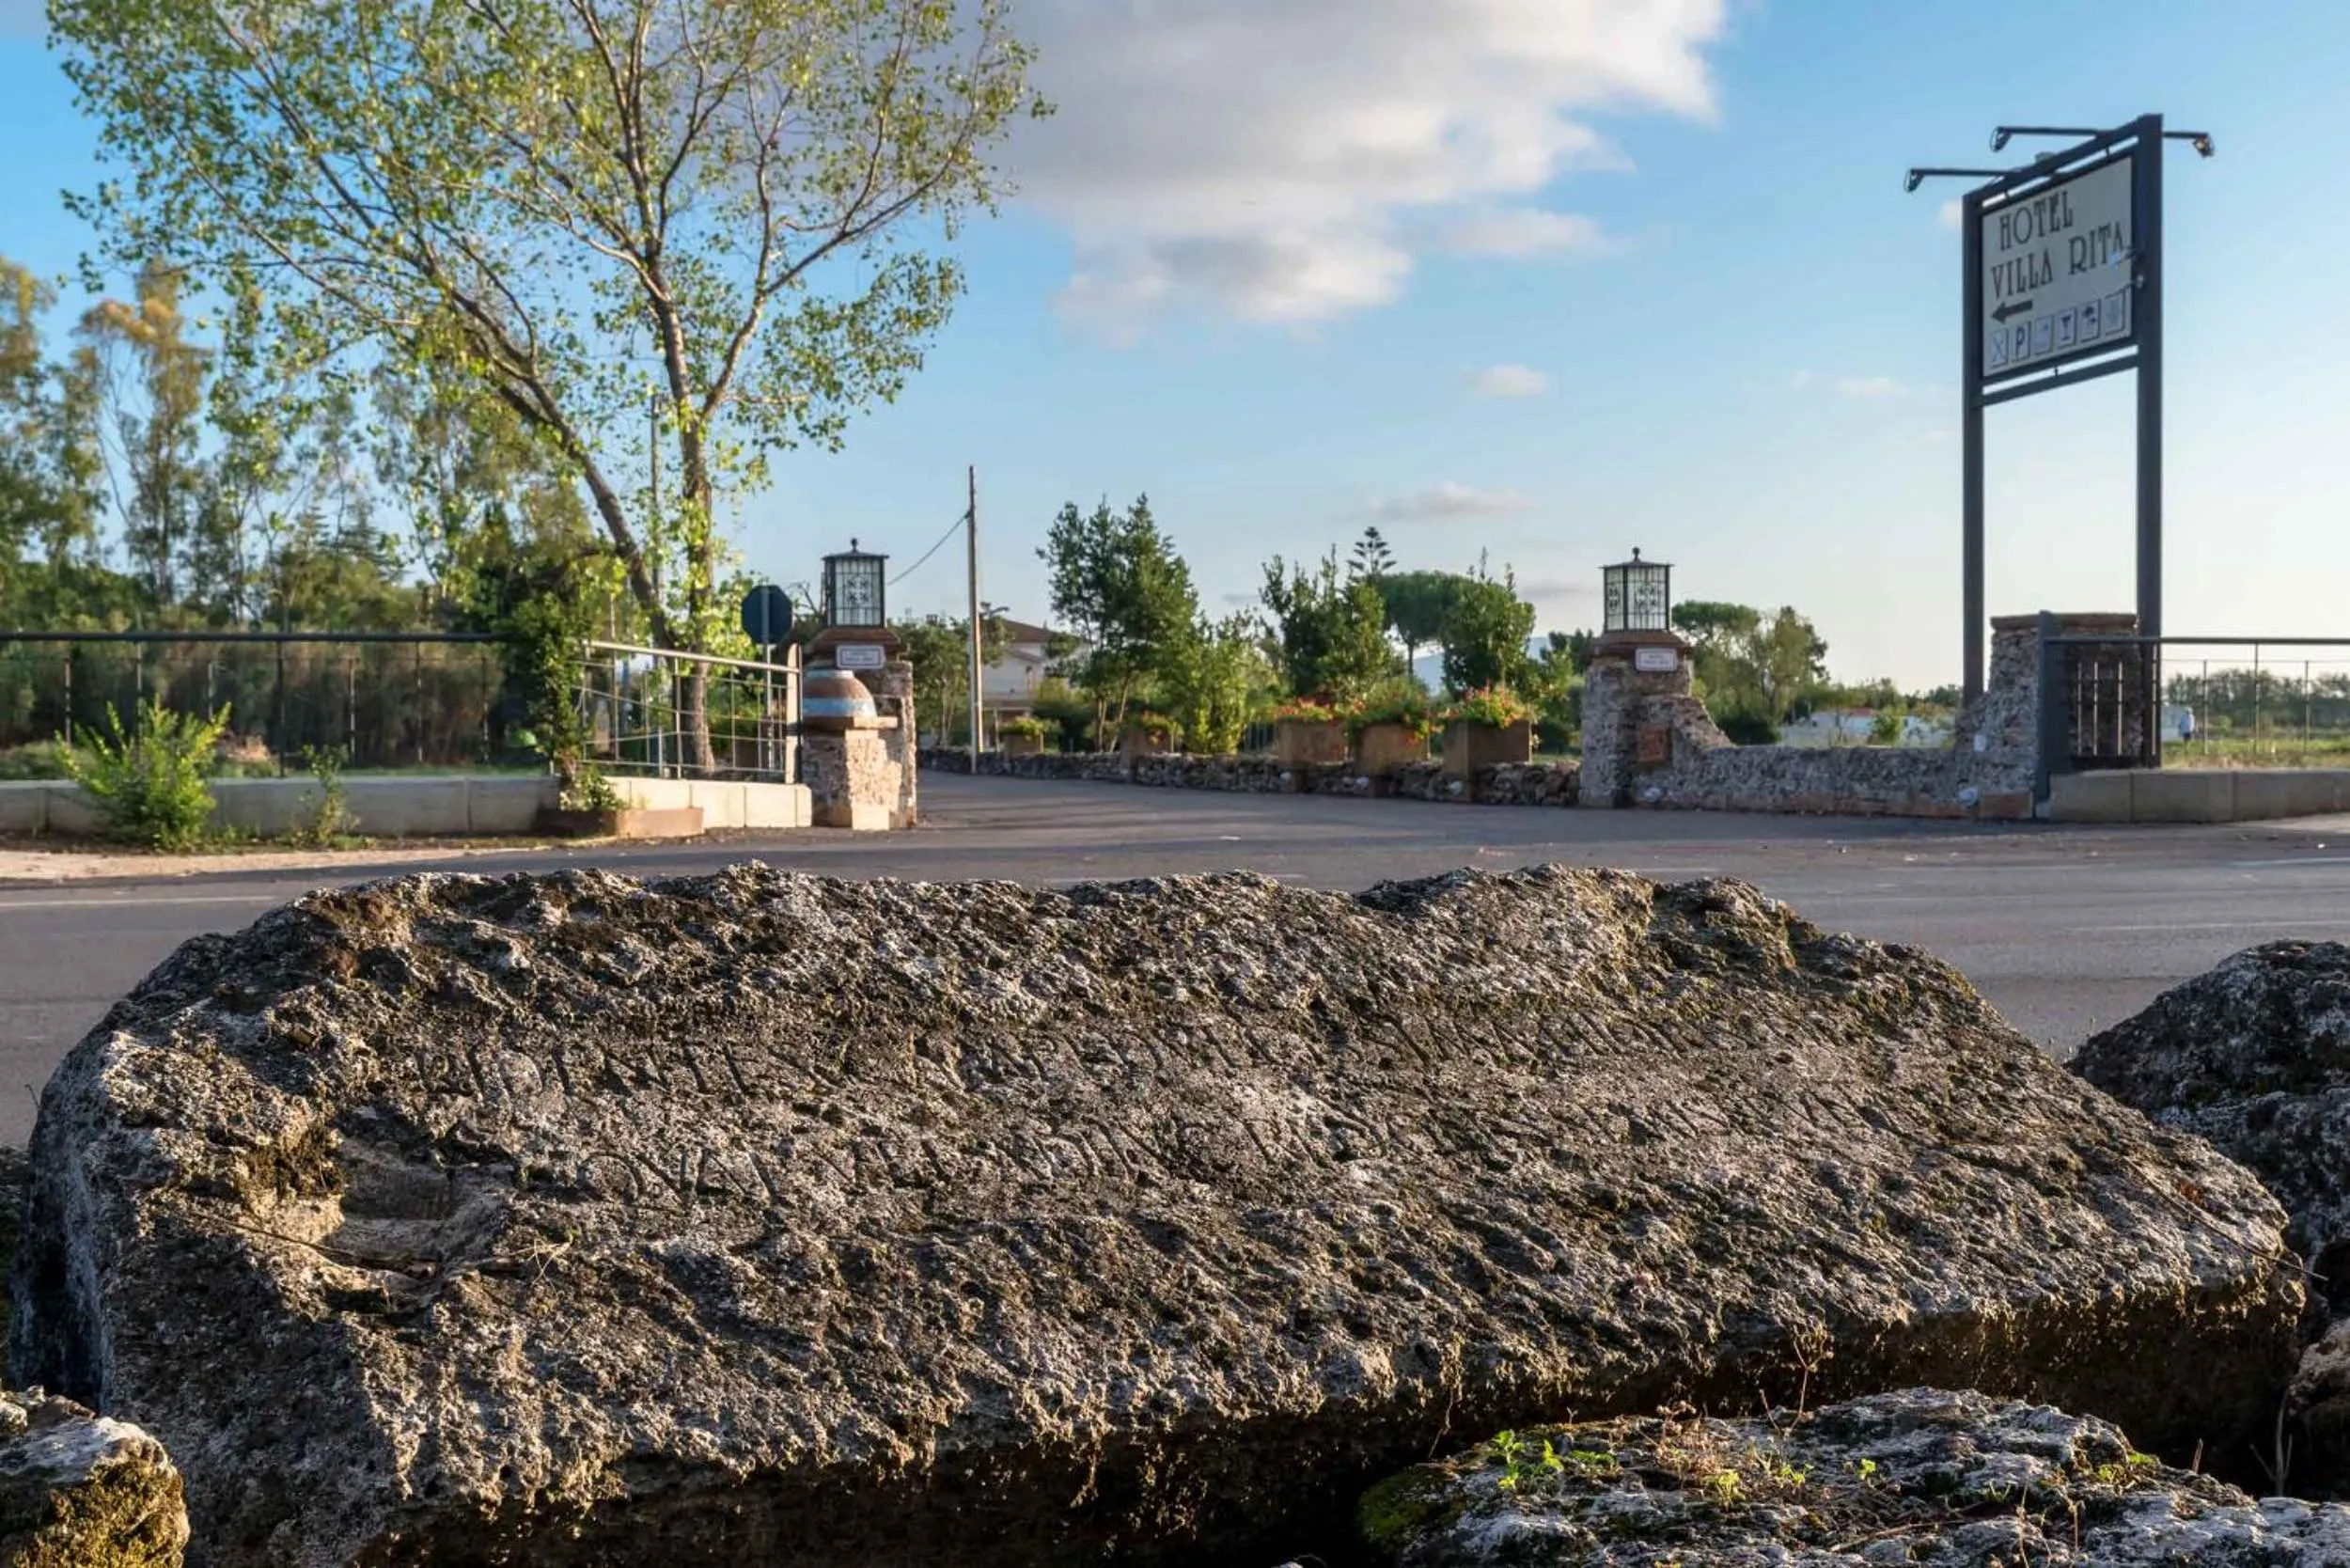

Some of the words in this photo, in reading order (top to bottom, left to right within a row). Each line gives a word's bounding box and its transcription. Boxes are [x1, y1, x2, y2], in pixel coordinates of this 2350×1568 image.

[1998, 191, 2073, 251] HOTEL
[1990, 248, 2053, 299] VILLA
[2068, 220, 2124, 275] RITA
